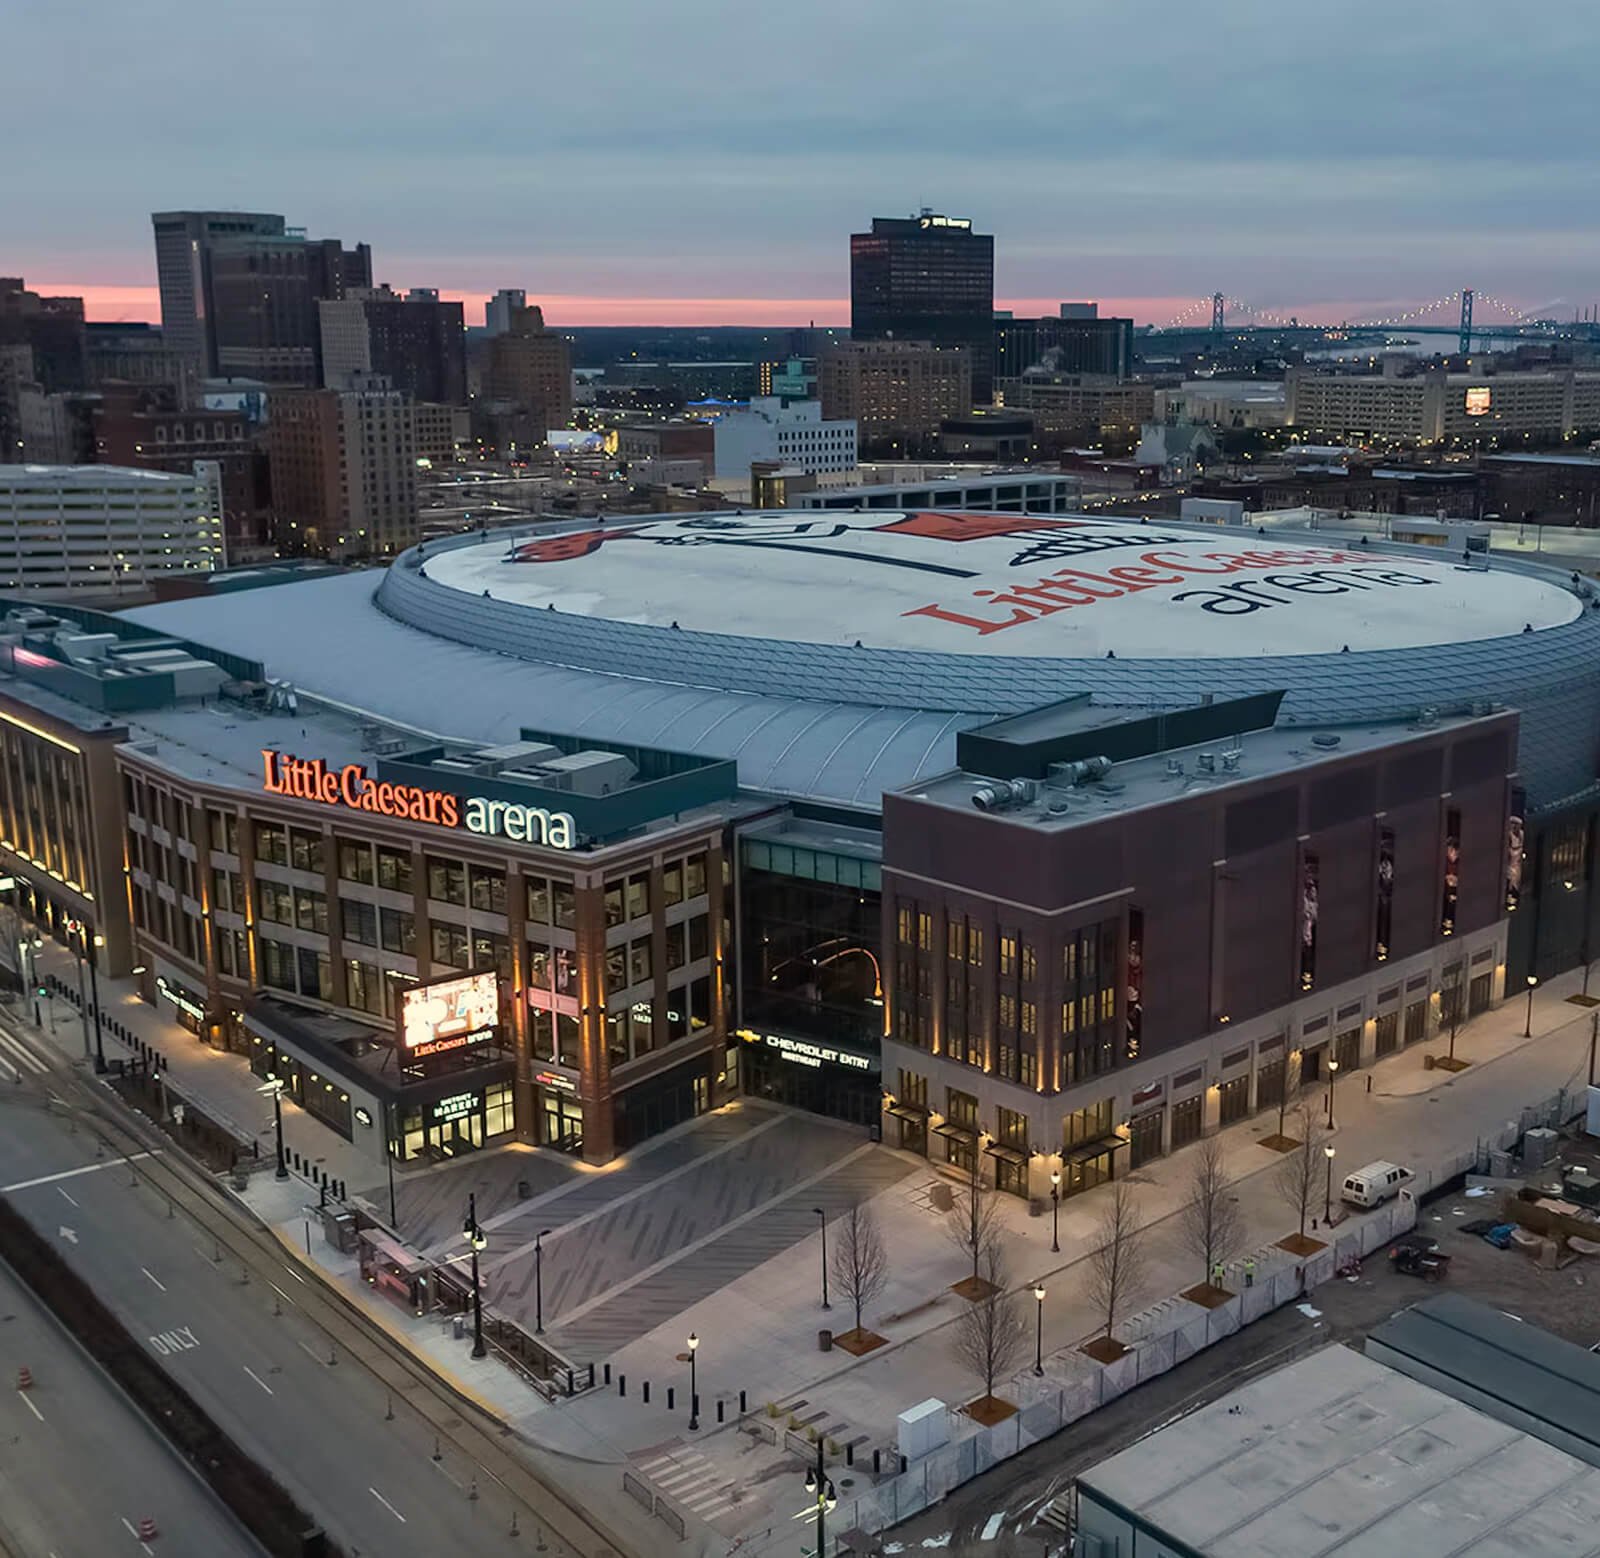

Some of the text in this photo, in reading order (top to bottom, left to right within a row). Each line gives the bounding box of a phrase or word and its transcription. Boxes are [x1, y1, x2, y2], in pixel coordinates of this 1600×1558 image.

[900, 566, 1184, 635] Little
[1171, 567, 1441, 615] arena
[262, 749, 577, 850] Little Caesars arena
[766, 1035, 838, 1061] CHEVROLET
[434, 1096, 479, 1117] MARKET
[149, 1326, 200, 1354] ONLY
